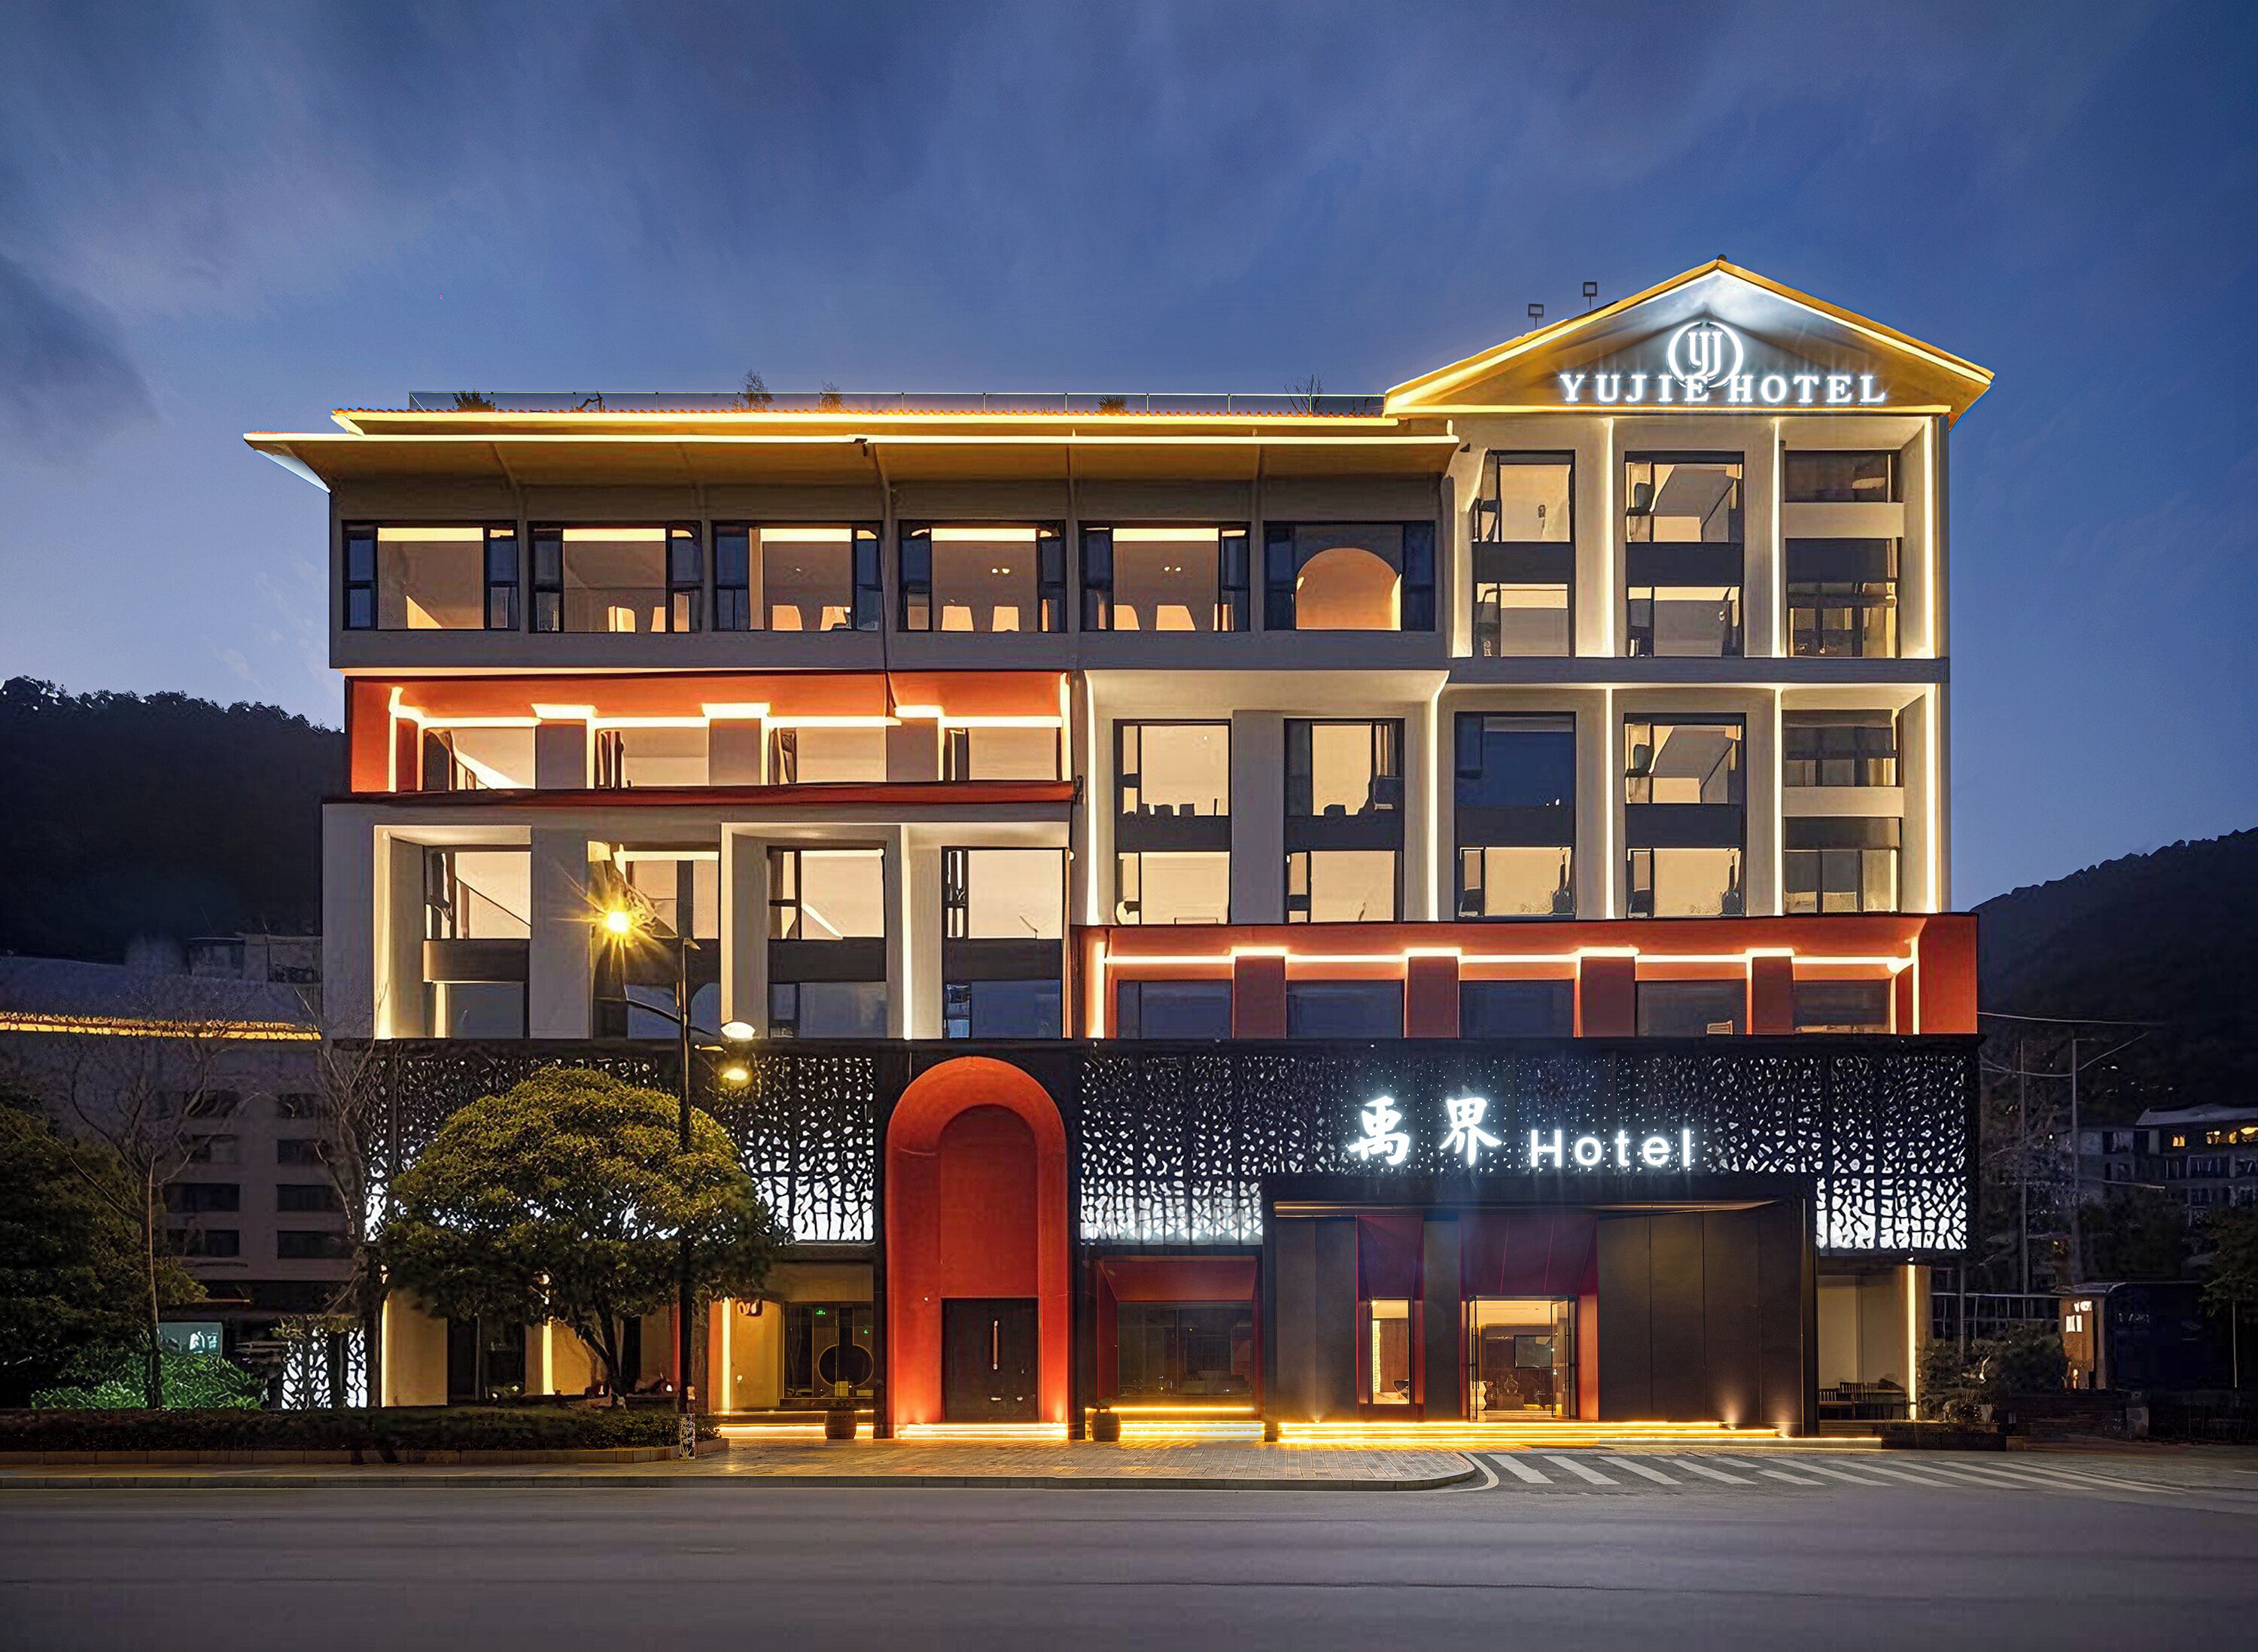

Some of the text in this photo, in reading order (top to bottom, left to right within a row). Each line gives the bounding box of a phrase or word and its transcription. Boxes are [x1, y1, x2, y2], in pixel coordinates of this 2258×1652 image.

[1560, 374, 1885, 403] YUJIE HOTEL
[1530, 1129, 1692, 1167] Hotel
